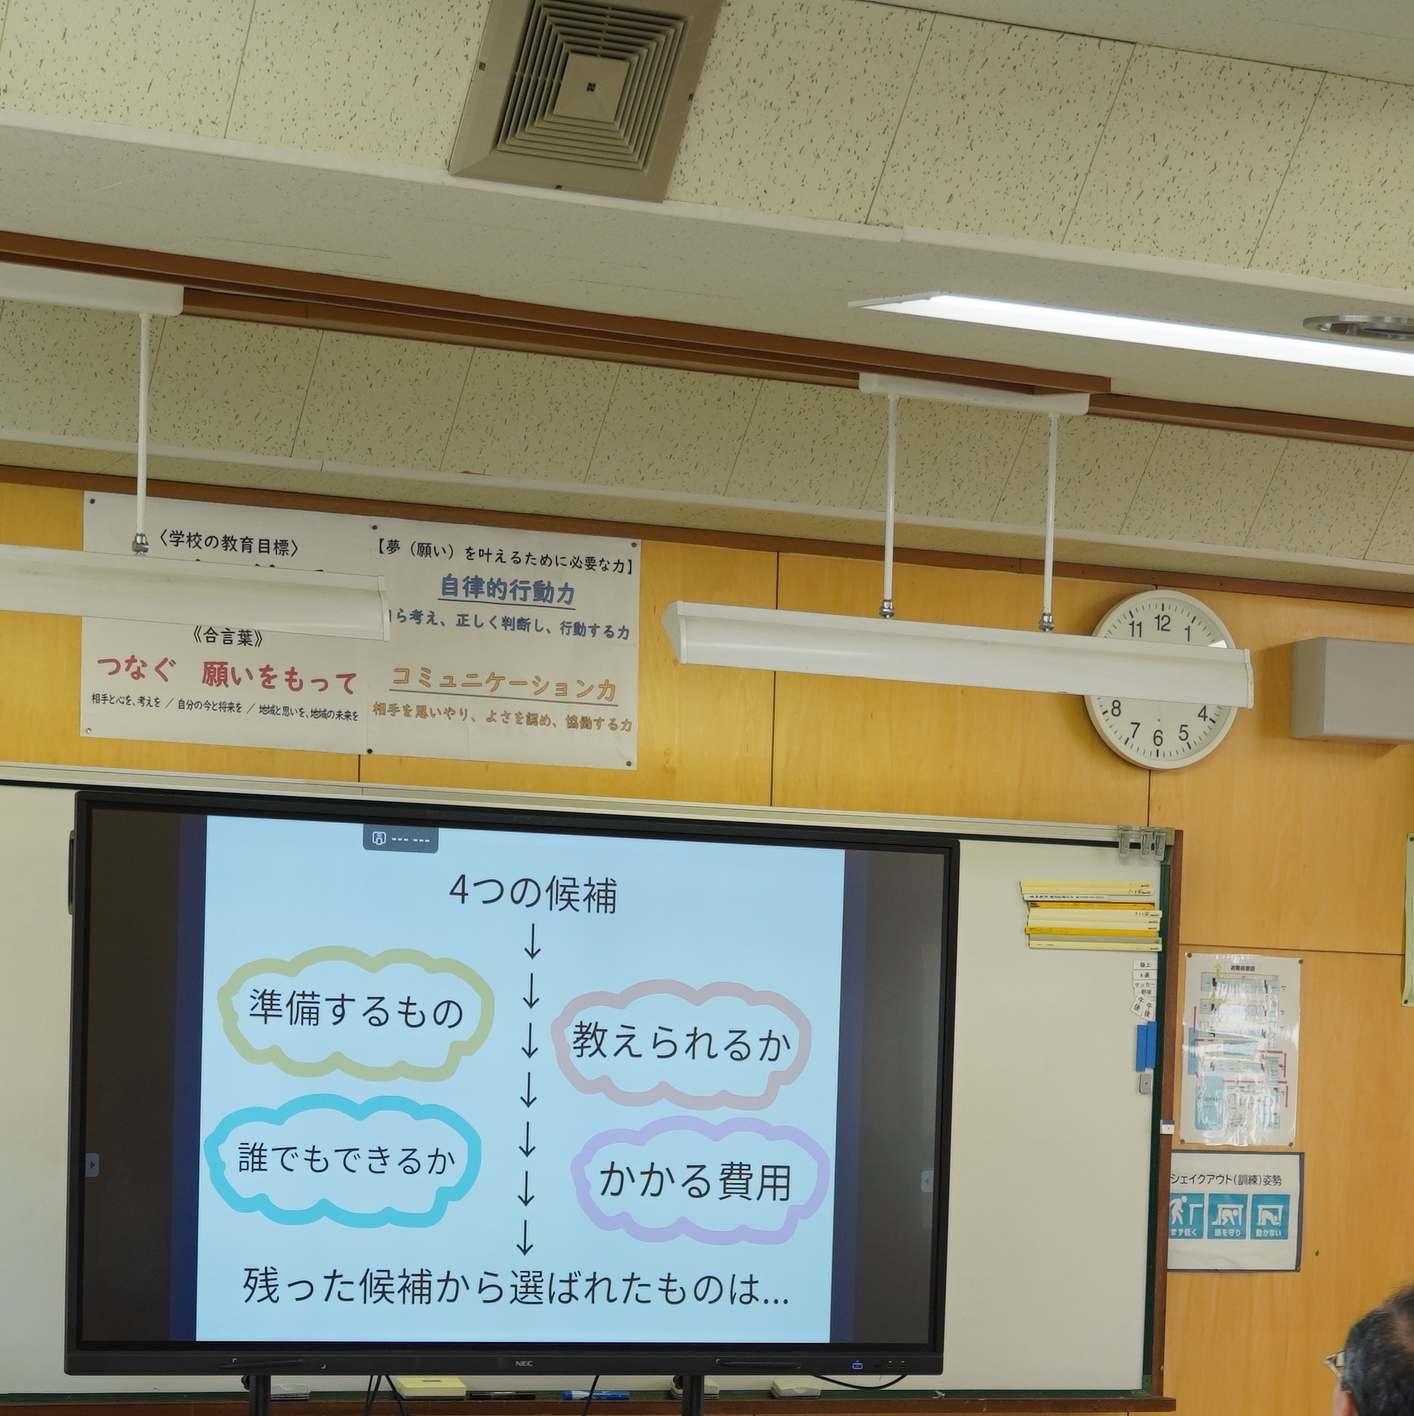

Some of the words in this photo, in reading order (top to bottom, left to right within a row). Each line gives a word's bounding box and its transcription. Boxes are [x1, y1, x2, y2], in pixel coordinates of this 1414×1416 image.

[441, 573, 576, 606] 自律的行動力
[193, 625, 263, 647] 《合言葉》
[388, 609, 630, 641] ら考え、正しく判断し、行動する力
[1128, 620, 1142, 638] 11
[1154, 614, 1171, 632] 12
[1184, 625, 1190, 642] 1
[97, 655, 176, 682] つなぐ
[202, 661, 356, 694] 願いをもって
[393, 666, 616, 702] コミュニケーション力
[1111, 700, 1121, 716] 8
[1198, 705, 1208, 722] 4
[1130, 722, 1140, 738] 7
[1153, 730, 1163, 746] 6
[1178, 724, 1188, 741] 5
[448, 870, 618, 916] 4つの候補
[248, 987, 466, 1031] 準備するもの
[571, 1019, 793, 1065] 教えられるか
[237, 1140, 457, 1176] 誰でもできるか
[599, 1160, 792, 1204] かかる費用
